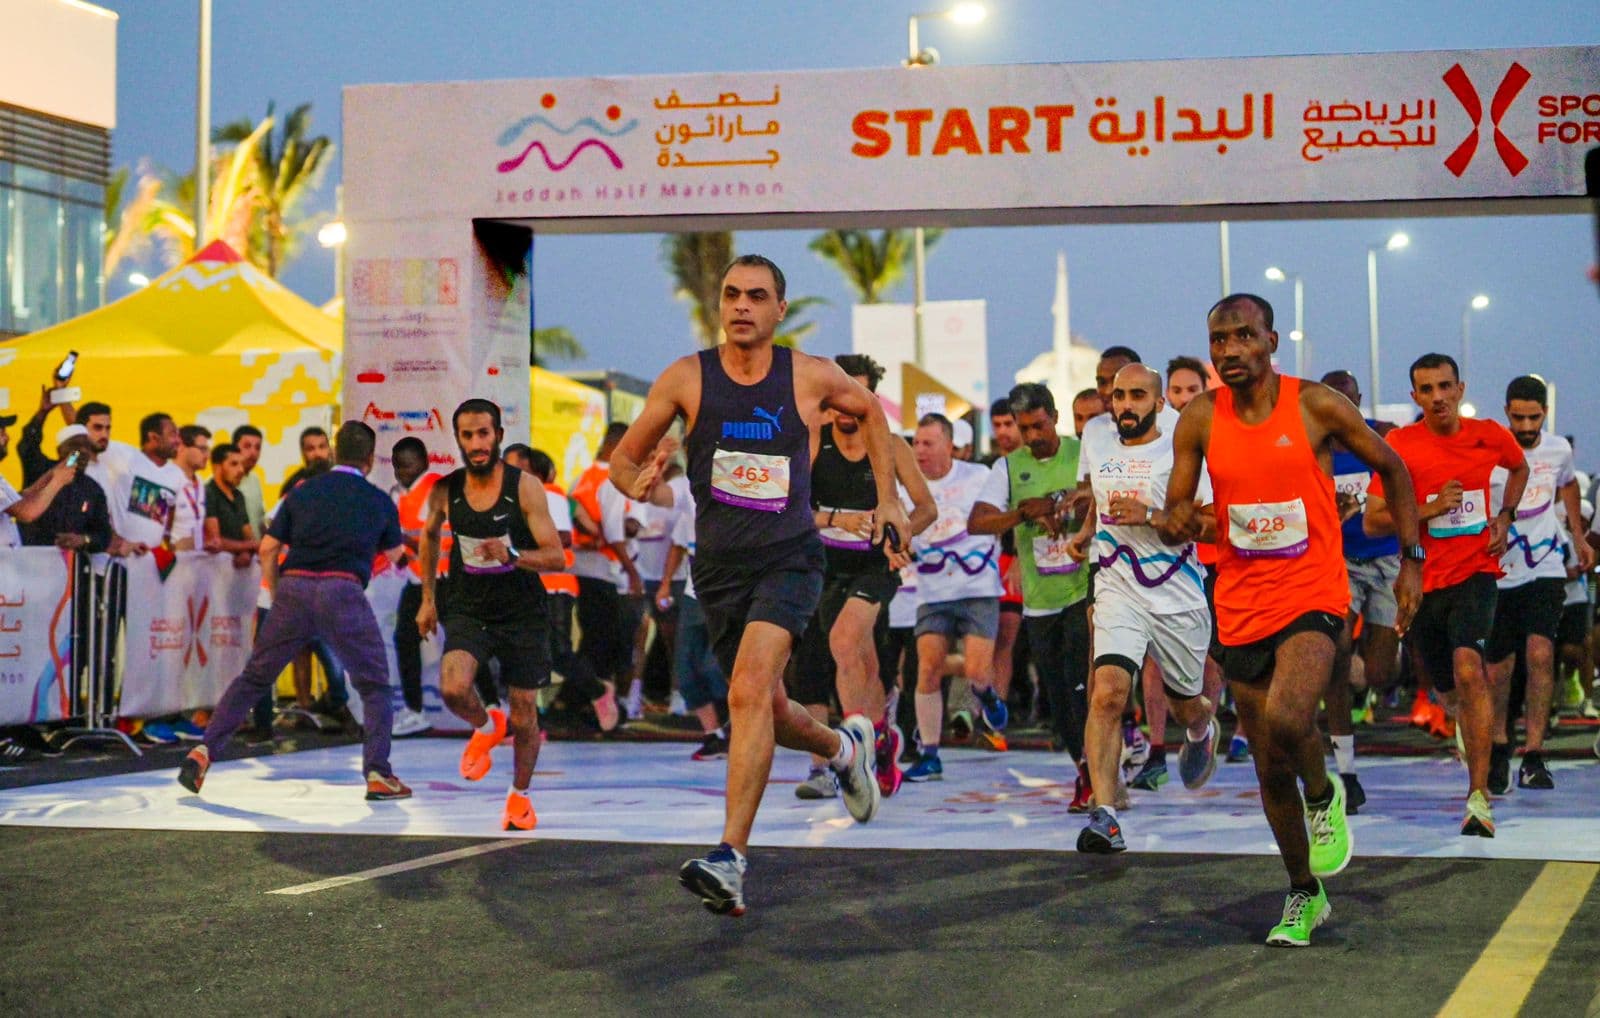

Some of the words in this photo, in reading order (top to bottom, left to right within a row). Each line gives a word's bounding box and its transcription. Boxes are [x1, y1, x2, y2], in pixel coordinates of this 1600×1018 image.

[654, 85, 780, 110] نصف
[1303, 98, 1436, 125] الرياضة
[655, 114, 780, 145] ماراثون
[851, 104, 1074, 158] START
[1088, 93, 1274, 157] البداية
[1537, 121, 1600, 144] FOR
[1302, 125, 1436, 161] للجميع
[656, 147, 780, 169] جدة
[596, 182, 649, 200] Half
[661, 181, 784, 198] Marathon
[722, 421, 773, 440] PUMA
[732, 464, 769, 483] 463
[1247, 515, 1286, 534] 428
